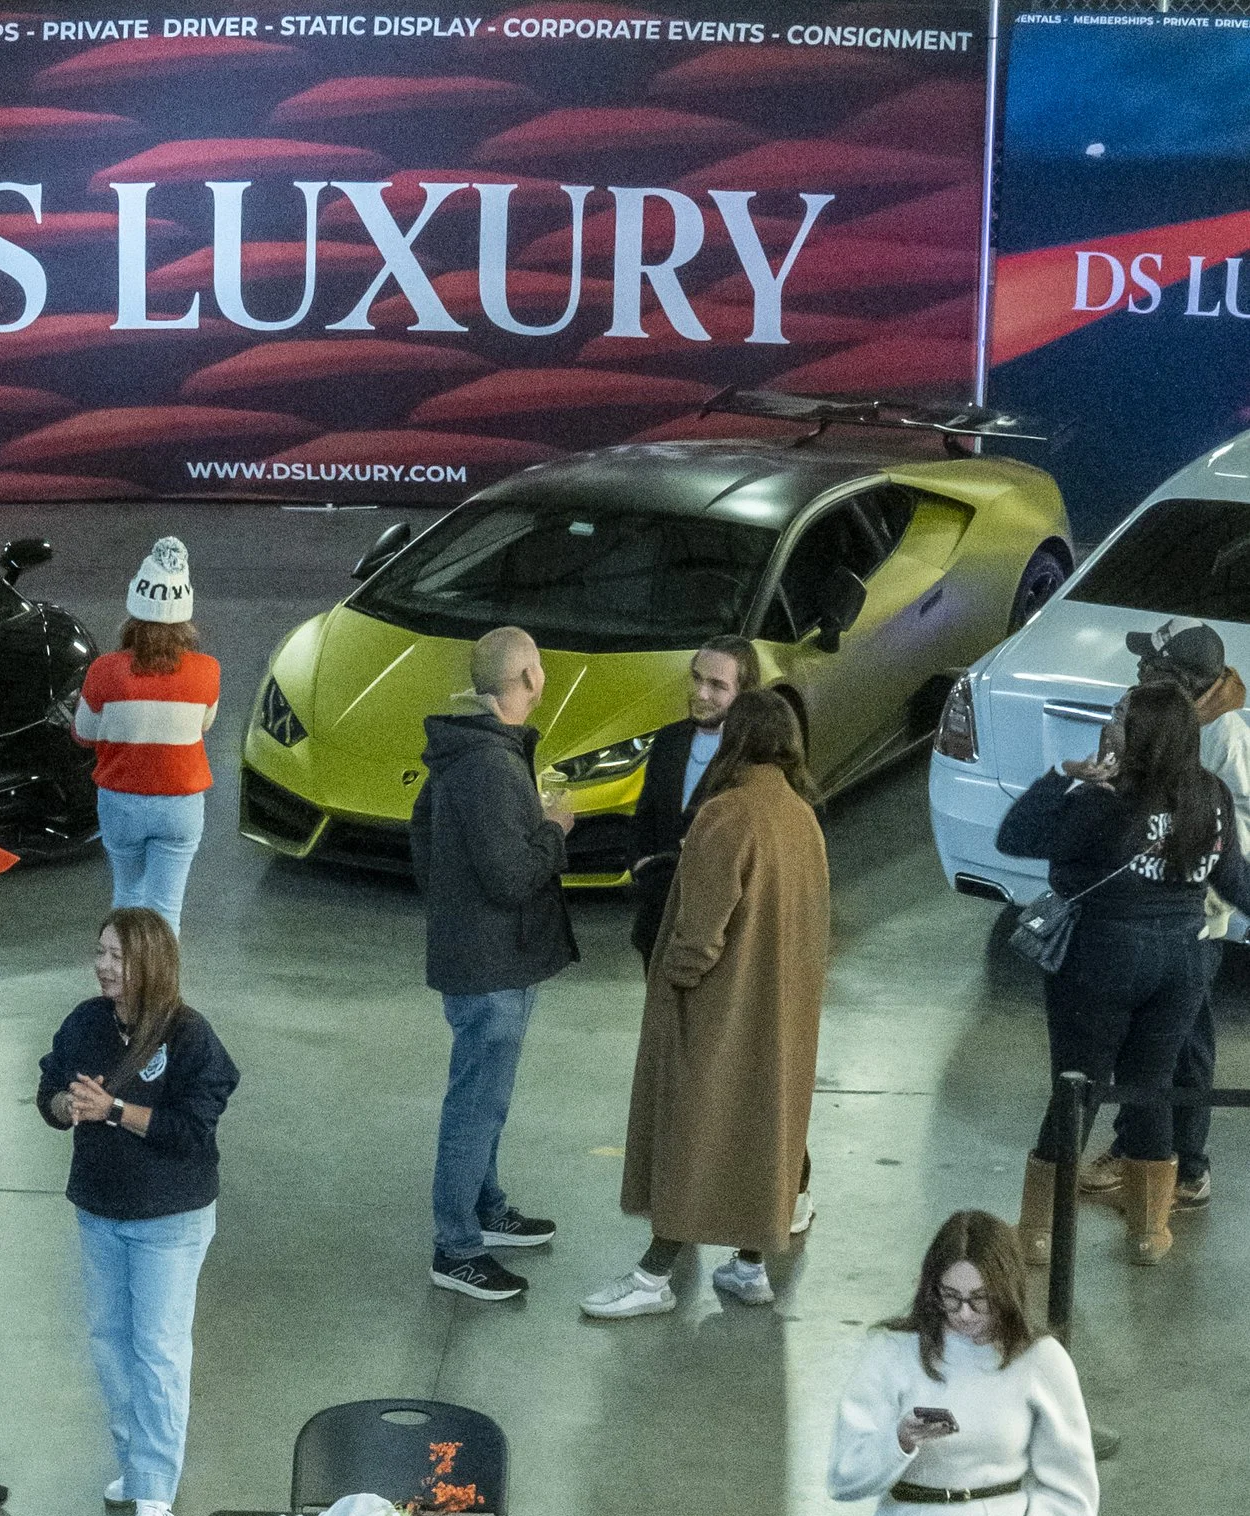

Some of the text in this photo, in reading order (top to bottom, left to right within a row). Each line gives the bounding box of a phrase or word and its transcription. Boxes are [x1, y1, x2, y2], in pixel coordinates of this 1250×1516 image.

[43, 19, 148, 41] PRIVATE
[163, 17, 258, 38] DRIVER
[280, 15, 366, 36] STATIC
[373, 16, 481, 37] DISPLAY
[503, 18, 660, 40] CORPORATE
[668, 21, 765, 43] EVENTS
[787, 25, 972, 51] CONSIGNMENT
[1073, 15, 1154, 26] MEMBERSHIPS
[1163, 17, 1209, 27] PRIVATE
[1215, 18, 1250, 28] DRIVE
[109, 181, 835, 344] LUXURY
[1072, 251, 1163, 314] DS
[186, 462, 467, 482] WWW.DSLUXURY.COM
